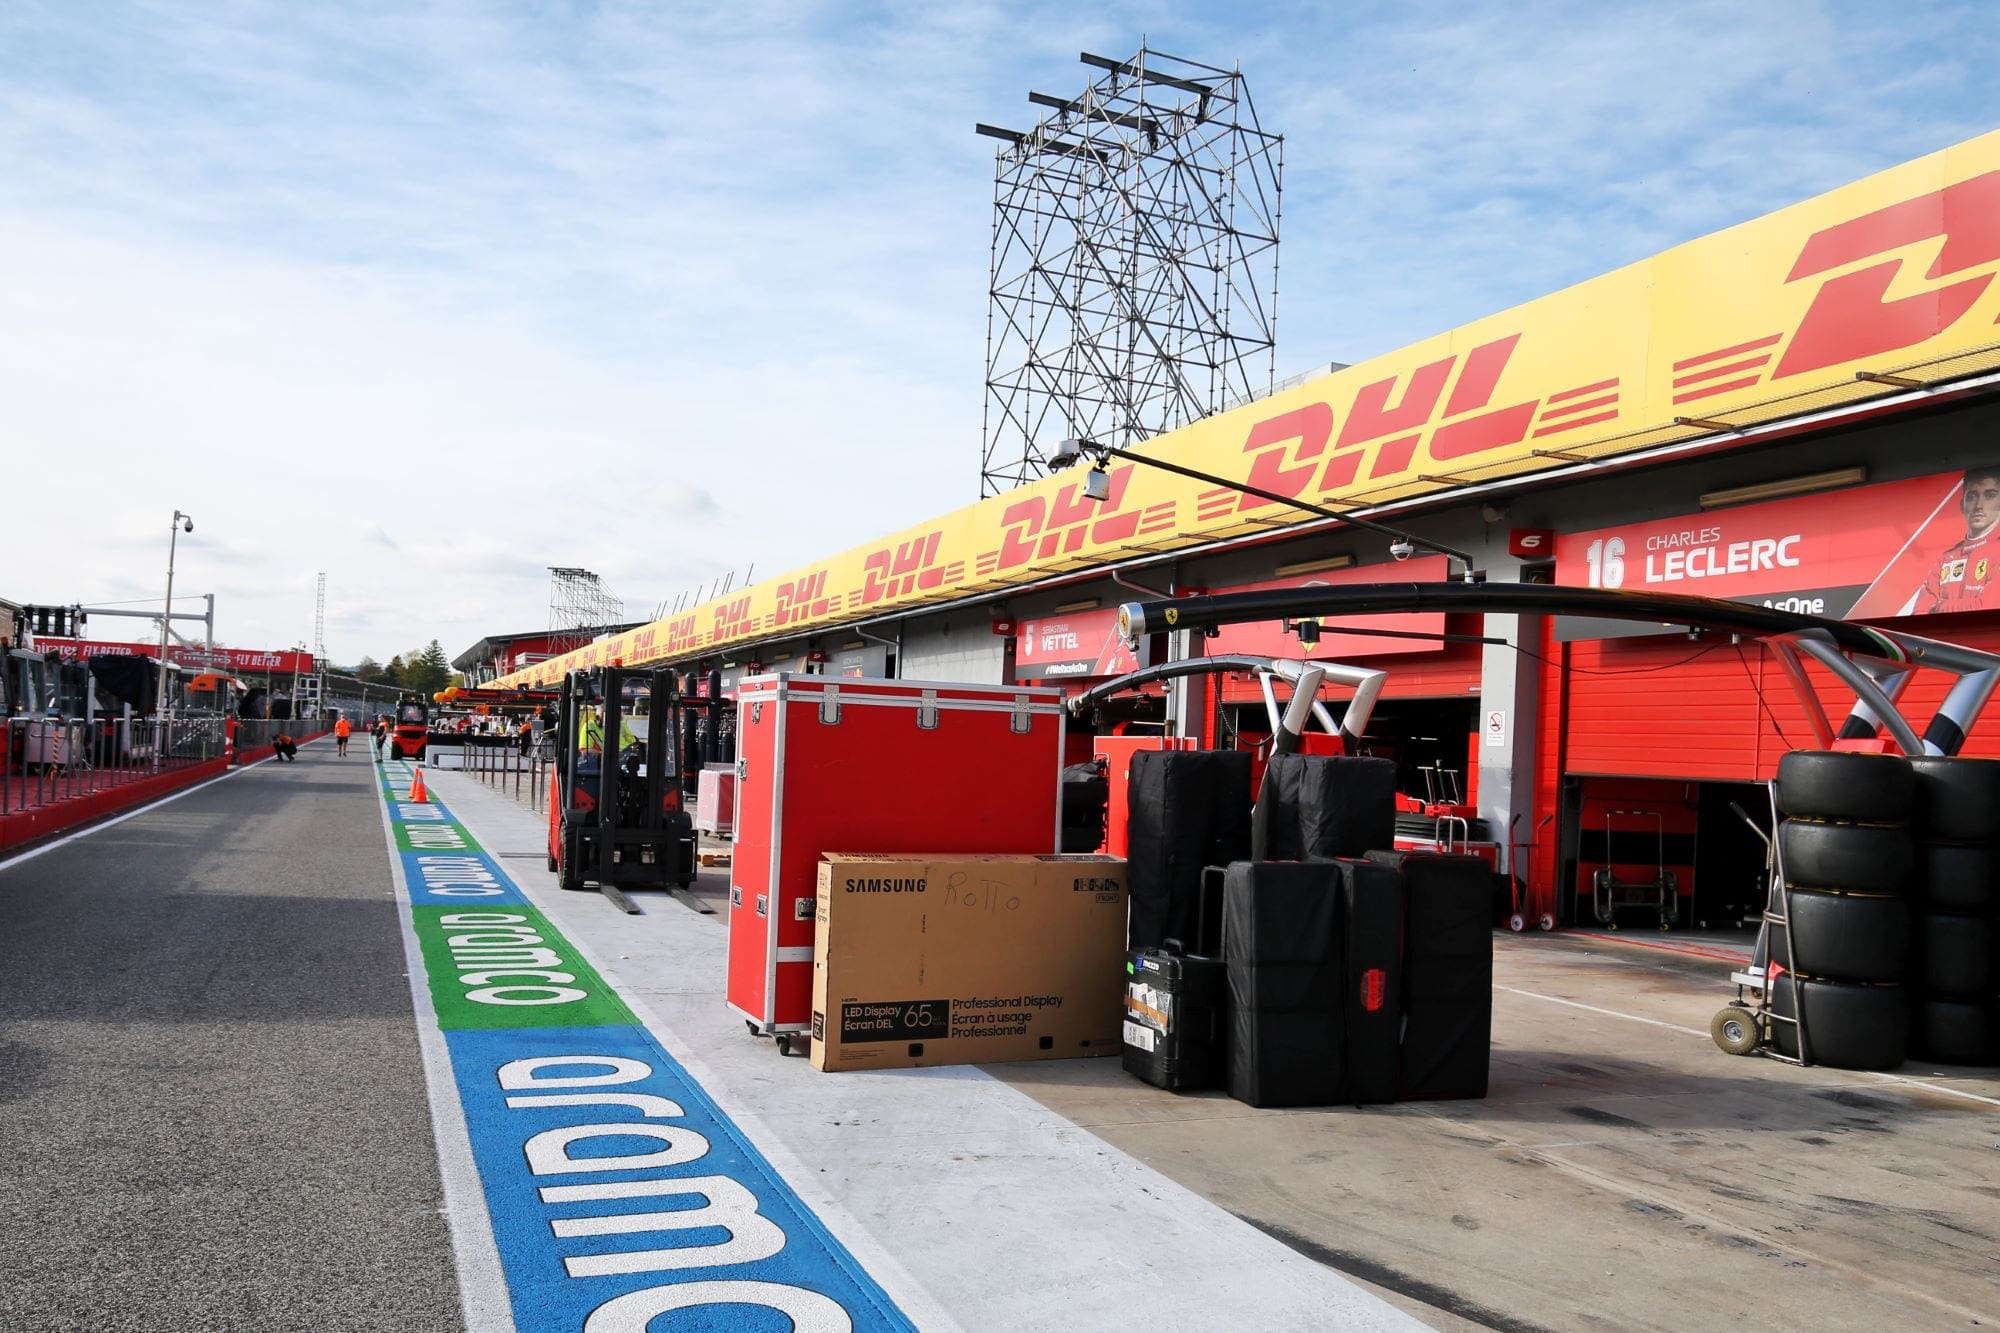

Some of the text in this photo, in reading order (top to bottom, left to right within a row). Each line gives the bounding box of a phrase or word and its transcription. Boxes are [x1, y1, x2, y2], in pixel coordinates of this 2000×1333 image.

[1237, 333, 1540, 512] DHL
[998, 464, 1141, 570] DHL
[1520, 535, 1542, 548] 6
[1646, 526, 1721, 551] CHARLES
[862, 531, 946, 605] DHL
[1586, 537, 1625, 589] 16
[1645, 534, 1801, 584] LECLERC
[775, 570, 830, 626] DHL
[713, 596, 754, 642] DHL
[1041, 624, 1069, 635] SEBASTIAN
[633, 628, 656, 661] DHL
[668, 615, 697, 653] DHL
[1024, 624, 1034, 657] 5
[1041, 632, 1079, 652] VETTEL
[236, 653, 249, 665] FLY
[417, 856, 505, 897] aramco
[845, 878, 927, 893] SAMSUNG
[439, 912, 588, 1007] aramco
[845, 1005, 901, 1018] LED Display
[904, 1004, 932, 1028] 65
[952, 995, 1063, 1009] Professional Display
[844, 1018, 893, 1031] Écran DEL
[952, 1011, 984, 1025] Écran
[986, 1012, 994, 1023] à
[997, 1012, 1032, 1025] usage
[952, 1025, 1027, 1038] Professionnel
